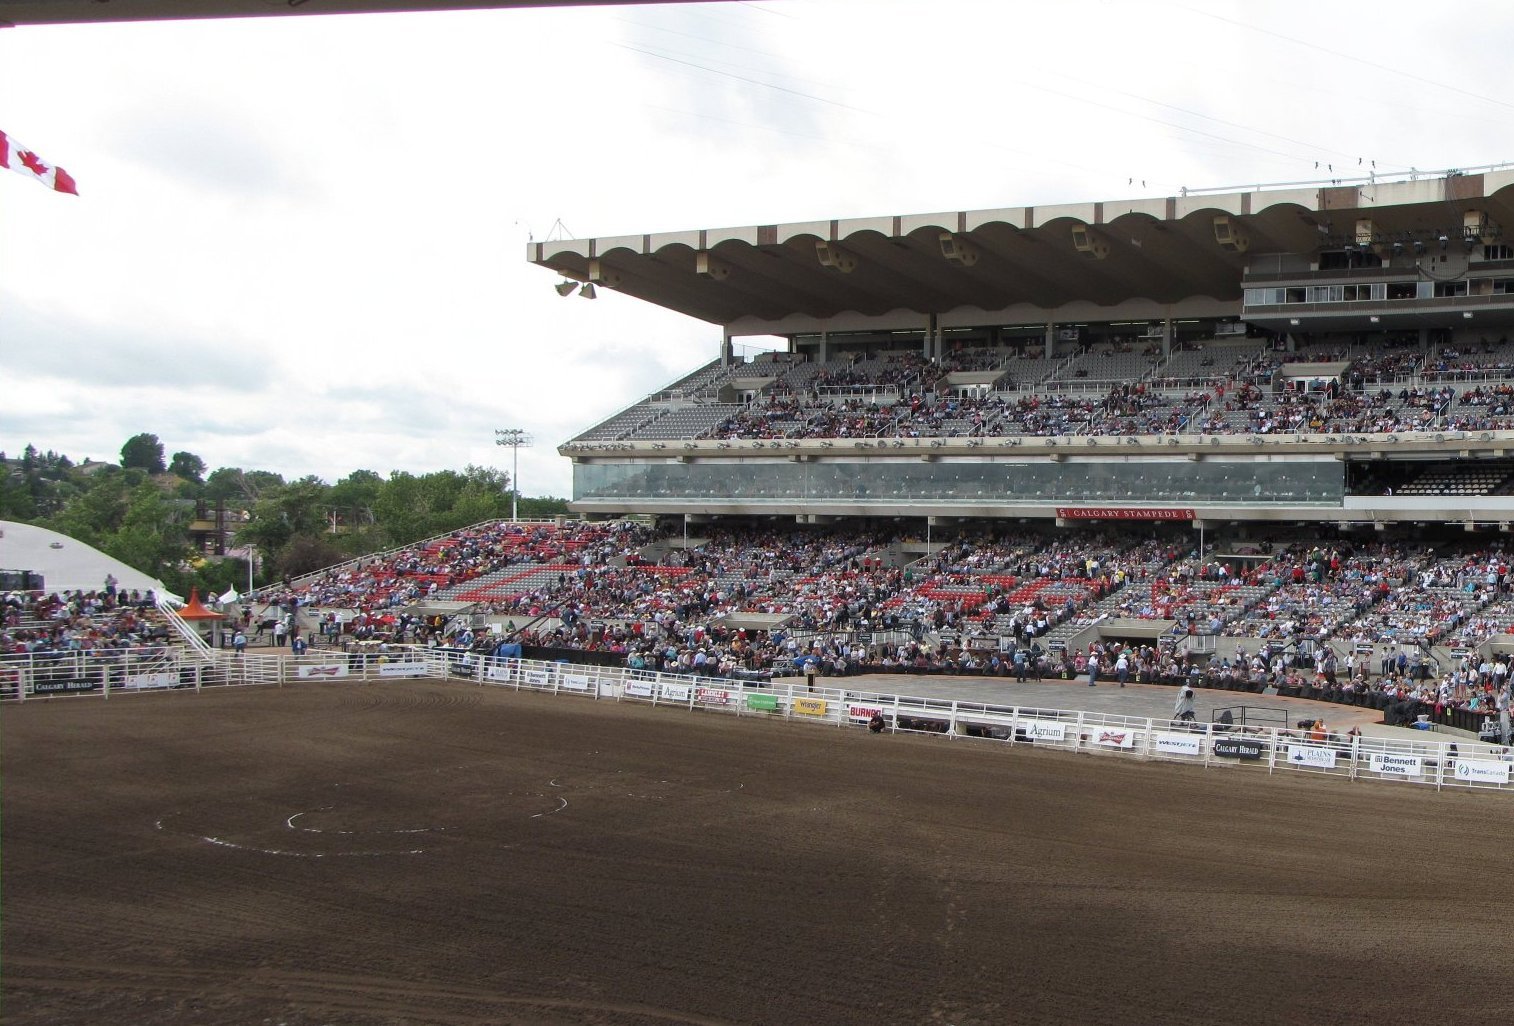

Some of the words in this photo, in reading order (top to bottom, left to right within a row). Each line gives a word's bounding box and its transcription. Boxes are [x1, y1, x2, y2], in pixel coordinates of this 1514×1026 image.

[1073, 510, 1119, 518] CALGARY
[1124, 510, 1179, 518] STAMPEDE
[36, 681, 64, 691] CALGARY
[664, 686, 686, 699] Agrium
[800, 700, 822, 712] Wrangler
[1030, 723, 1061, 737] Agrium
[1215, 743, 1238, 754] CALGARY
[1239, 745, 1259, 755] HERALD
[1307, 749, 1332, 758] PLAINS
[1383, 756, 1416, 766] Bennett
[1380, 763, 1406, 773] Jones
[1472, 768, 1506, 777] TransCanada
